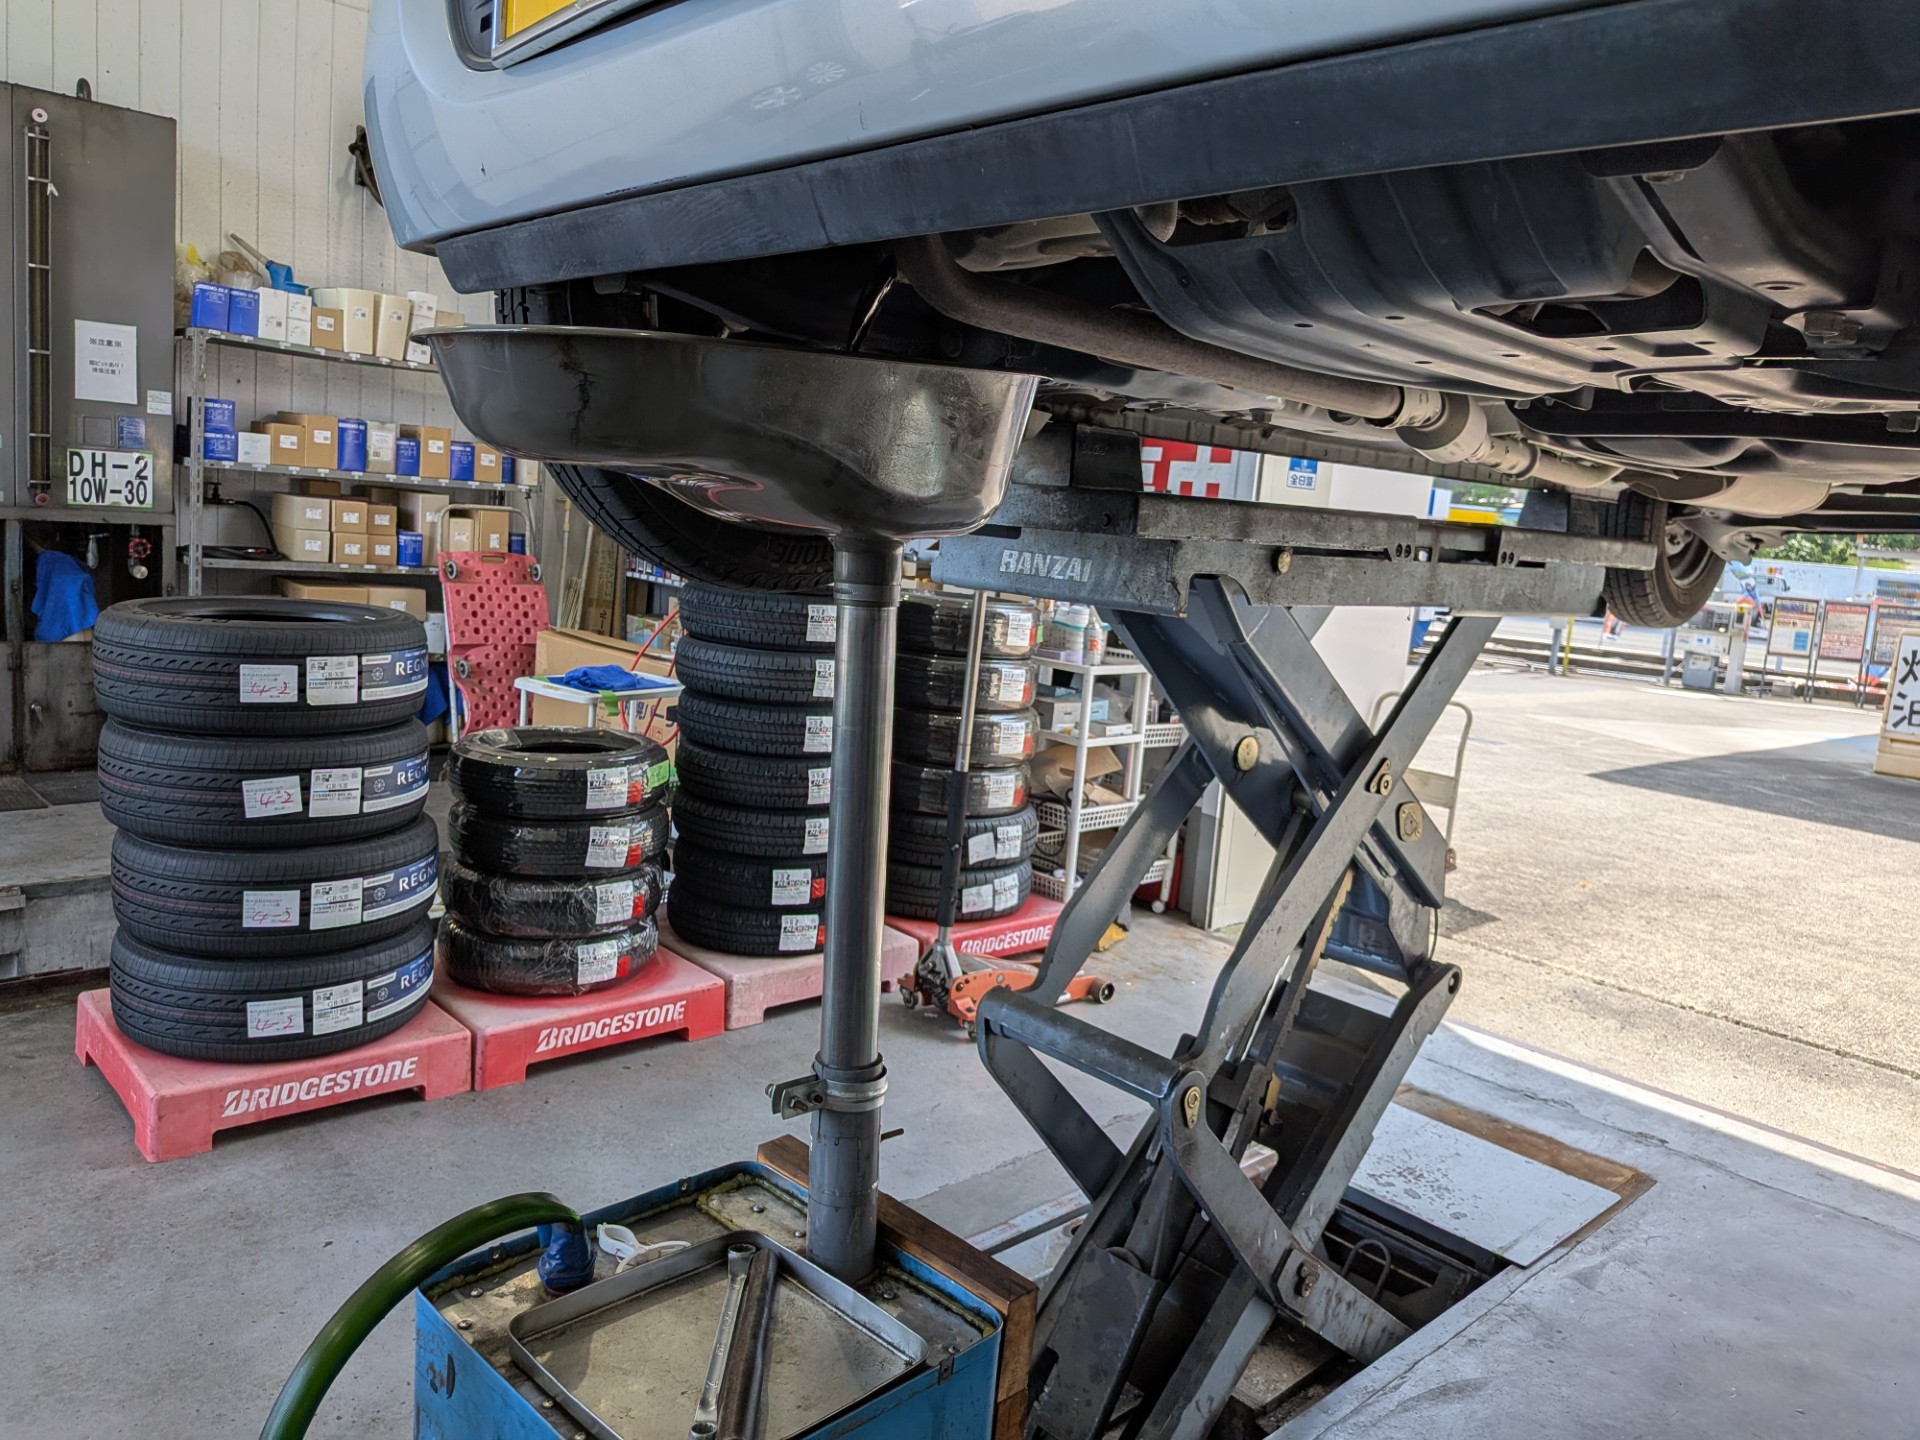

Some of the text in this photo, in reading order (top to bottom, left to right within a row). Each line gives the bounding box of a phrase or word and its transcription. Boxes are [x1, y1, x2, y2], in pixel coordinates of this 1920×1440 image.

[69, 477, 148, 505] 10W-30
[1000, 549, 1092, 582] BANZAI
[960, 924, 1052, 954] BRIDGESTONE
[535, 1000, 687, 1053] BRIDGESTONE
[221, 1056, 419, 1118] BRIDGESTONE
